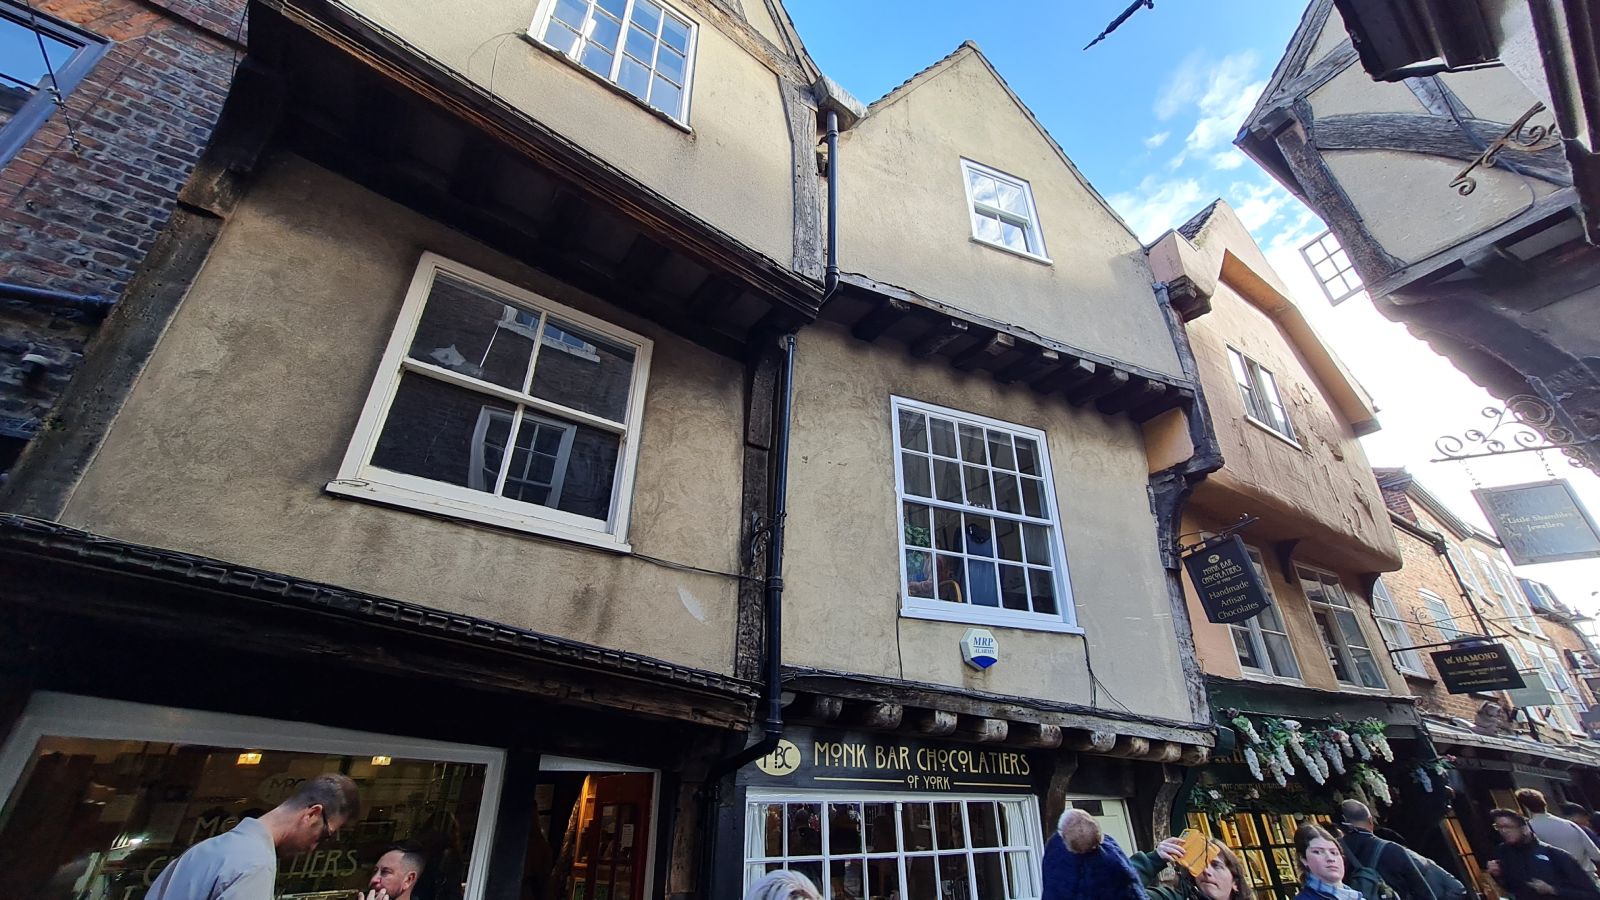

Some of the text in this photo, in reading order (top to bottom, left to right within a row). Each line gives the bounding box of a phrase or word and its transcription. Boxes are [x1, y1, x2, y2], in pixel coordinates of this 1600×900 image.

[1220, 558, 1234, 569] BAR
[1208, 580, 1249, 600] Handmade
[1221, 594, 1247, 607] Artisan
[1217, 601, 1260, 620] Chocolates
[973, 636, 994, 646] MRP
[814, 741, 1031, 776] MONK BAR CHOCOLATIERS
[907, 775, 951, 791] OF YORK
